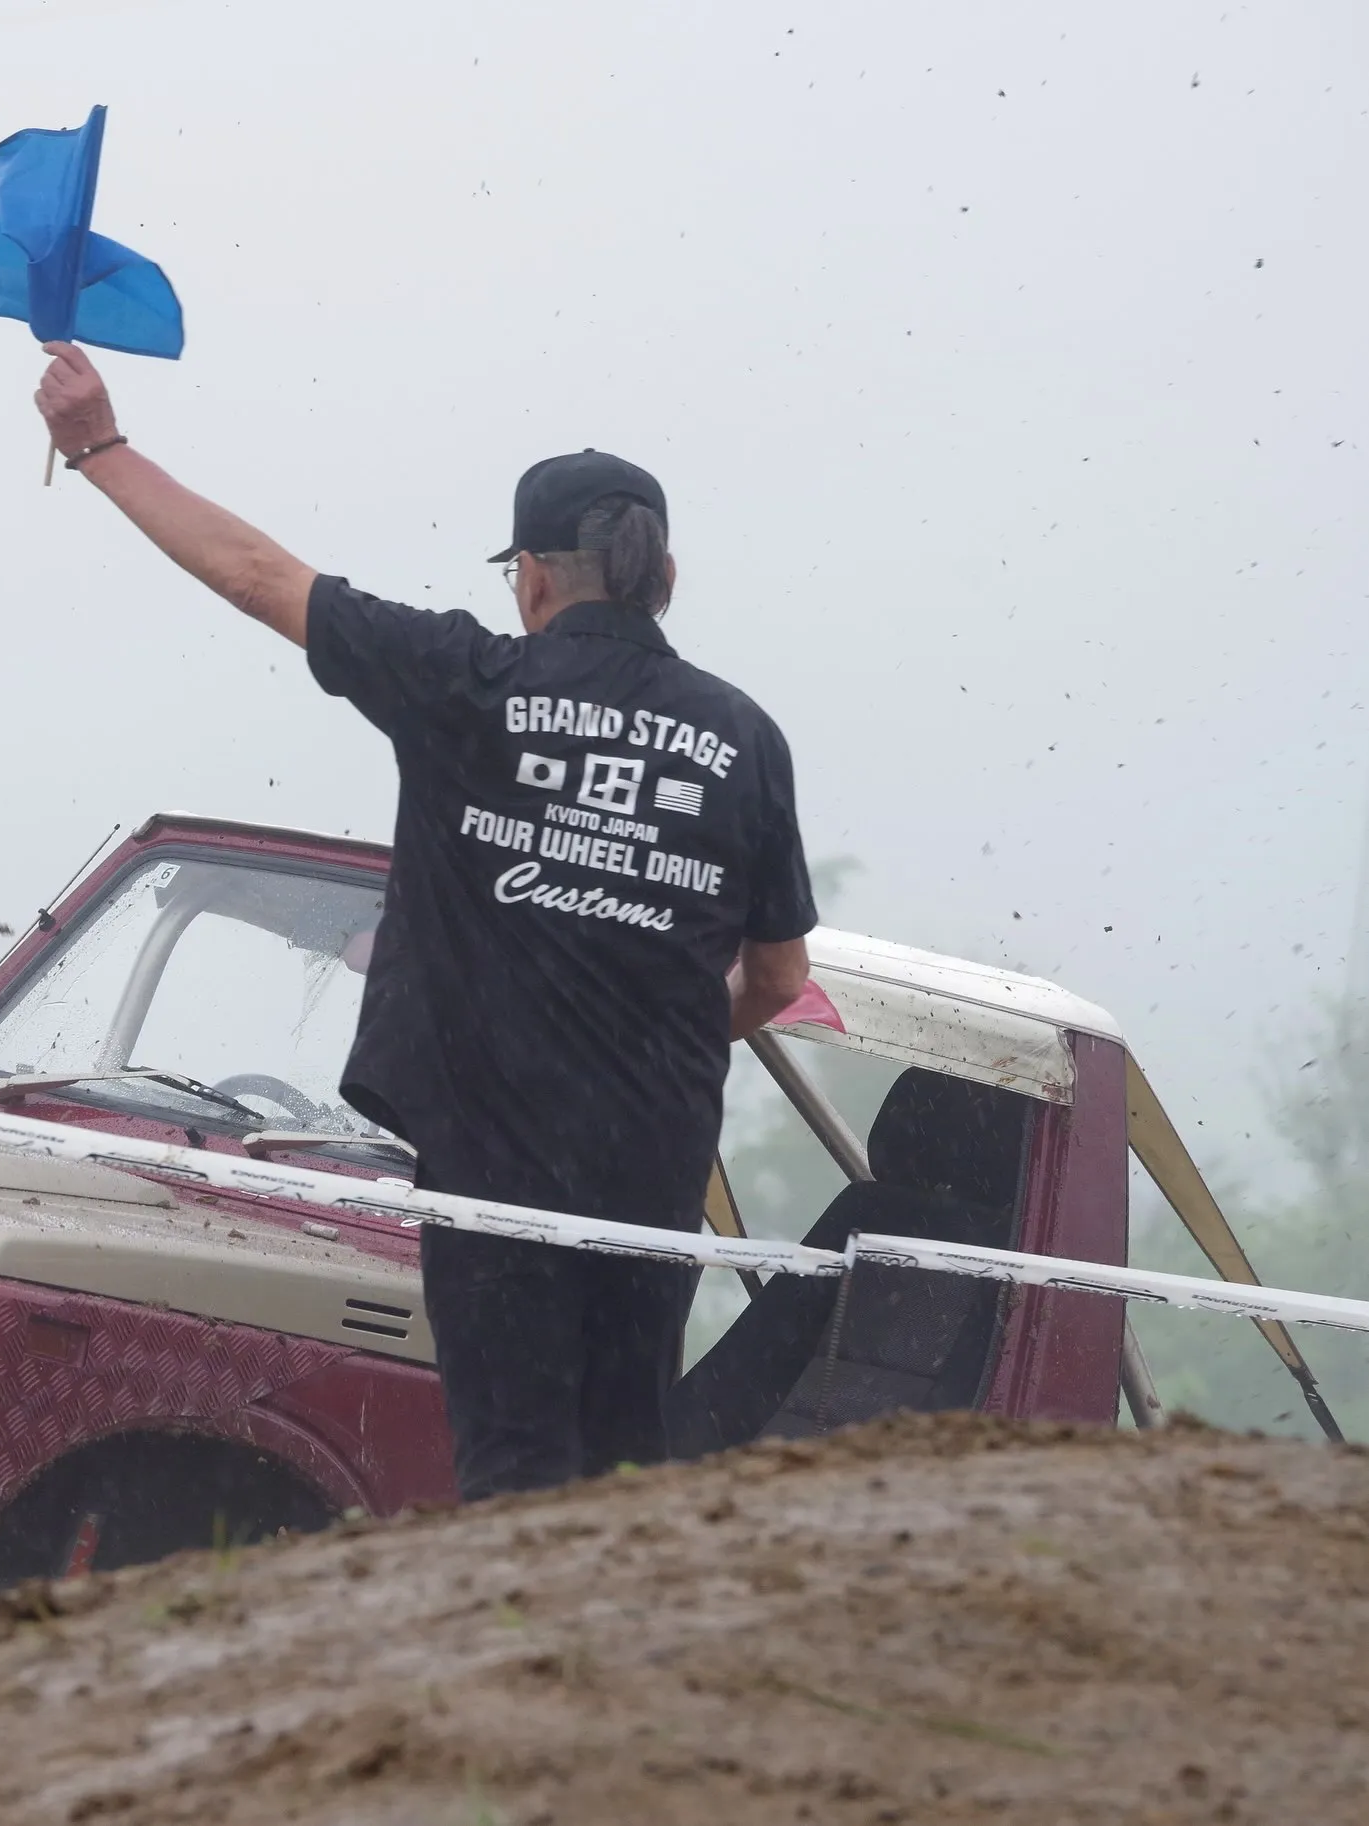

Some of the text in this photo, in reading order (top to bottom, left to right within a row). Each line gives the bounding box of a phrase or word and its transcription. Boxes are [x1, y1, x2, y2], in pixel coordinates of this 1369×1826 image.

[506, 696, 738, 779] GRAND STAGE
[460, 805, 725, 895] FOUR WHEEL DRIVE
[544, 803, 659, 843] KYOTO JAPAN
[494, 861, 674, 931] Customs
